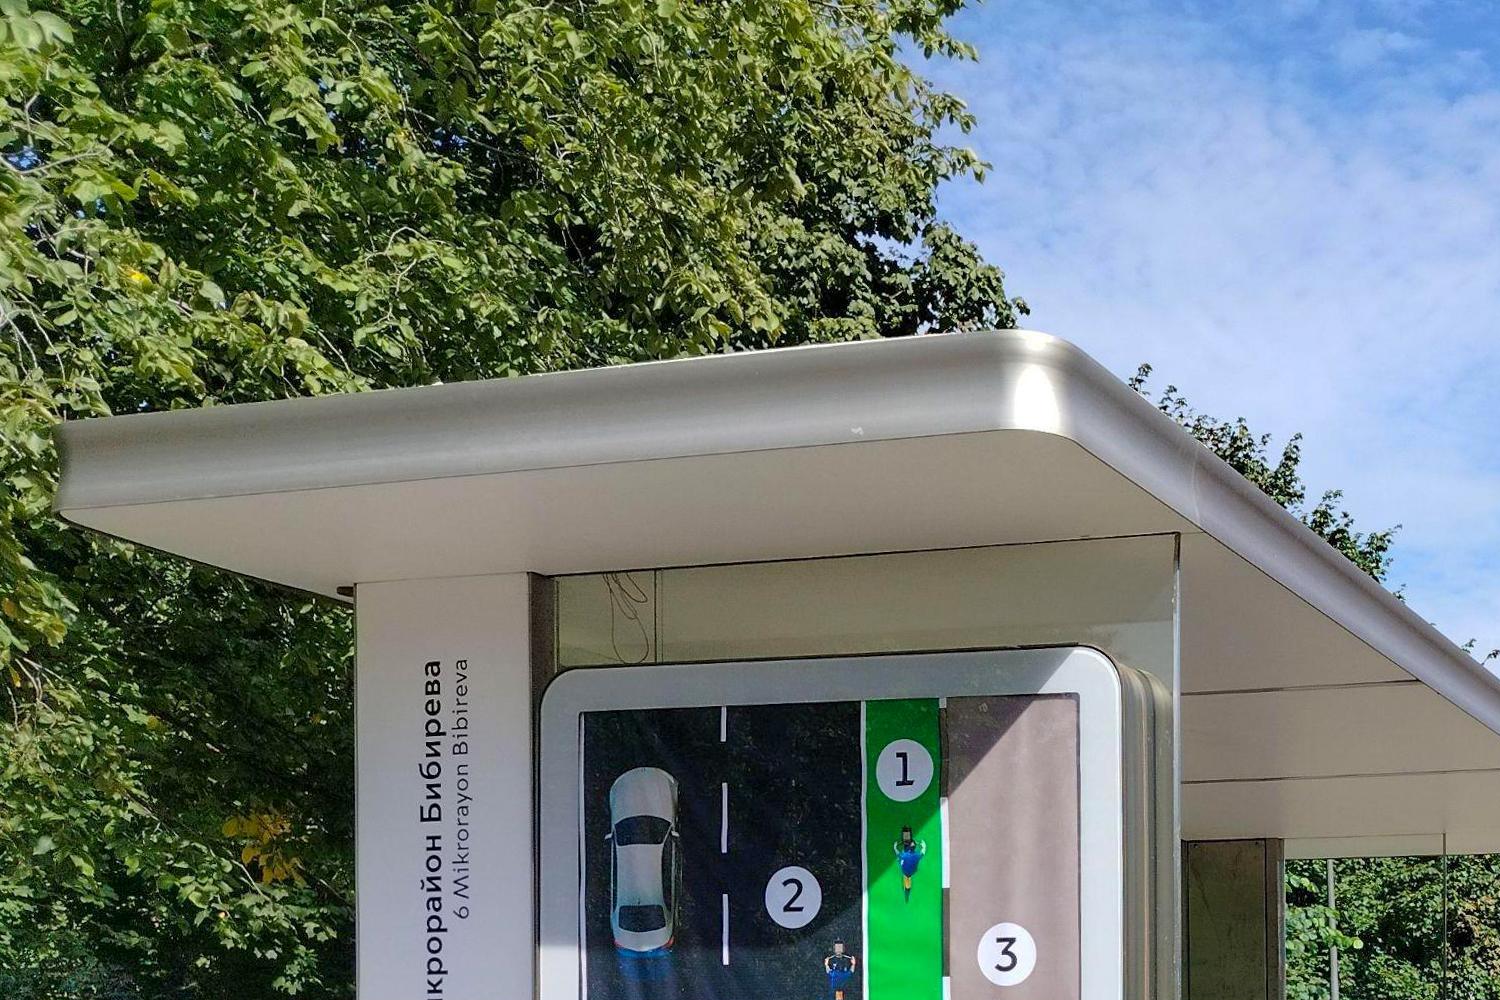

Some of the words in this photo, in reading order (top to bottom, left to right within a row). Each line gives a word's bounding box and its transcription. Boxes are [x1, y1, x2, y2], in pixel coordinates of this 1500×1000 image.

[451, 659, 469, 755] Bibireva
[418, 661, 447, 822] Бибирева
[895, 752, 914, 786] 1
[452, 764, 473, 899] Mikrorayon
[453, 906, 469, 919] 6
[782, 878, 804, 912] 2
[994, 937, 1018, 972] 3
